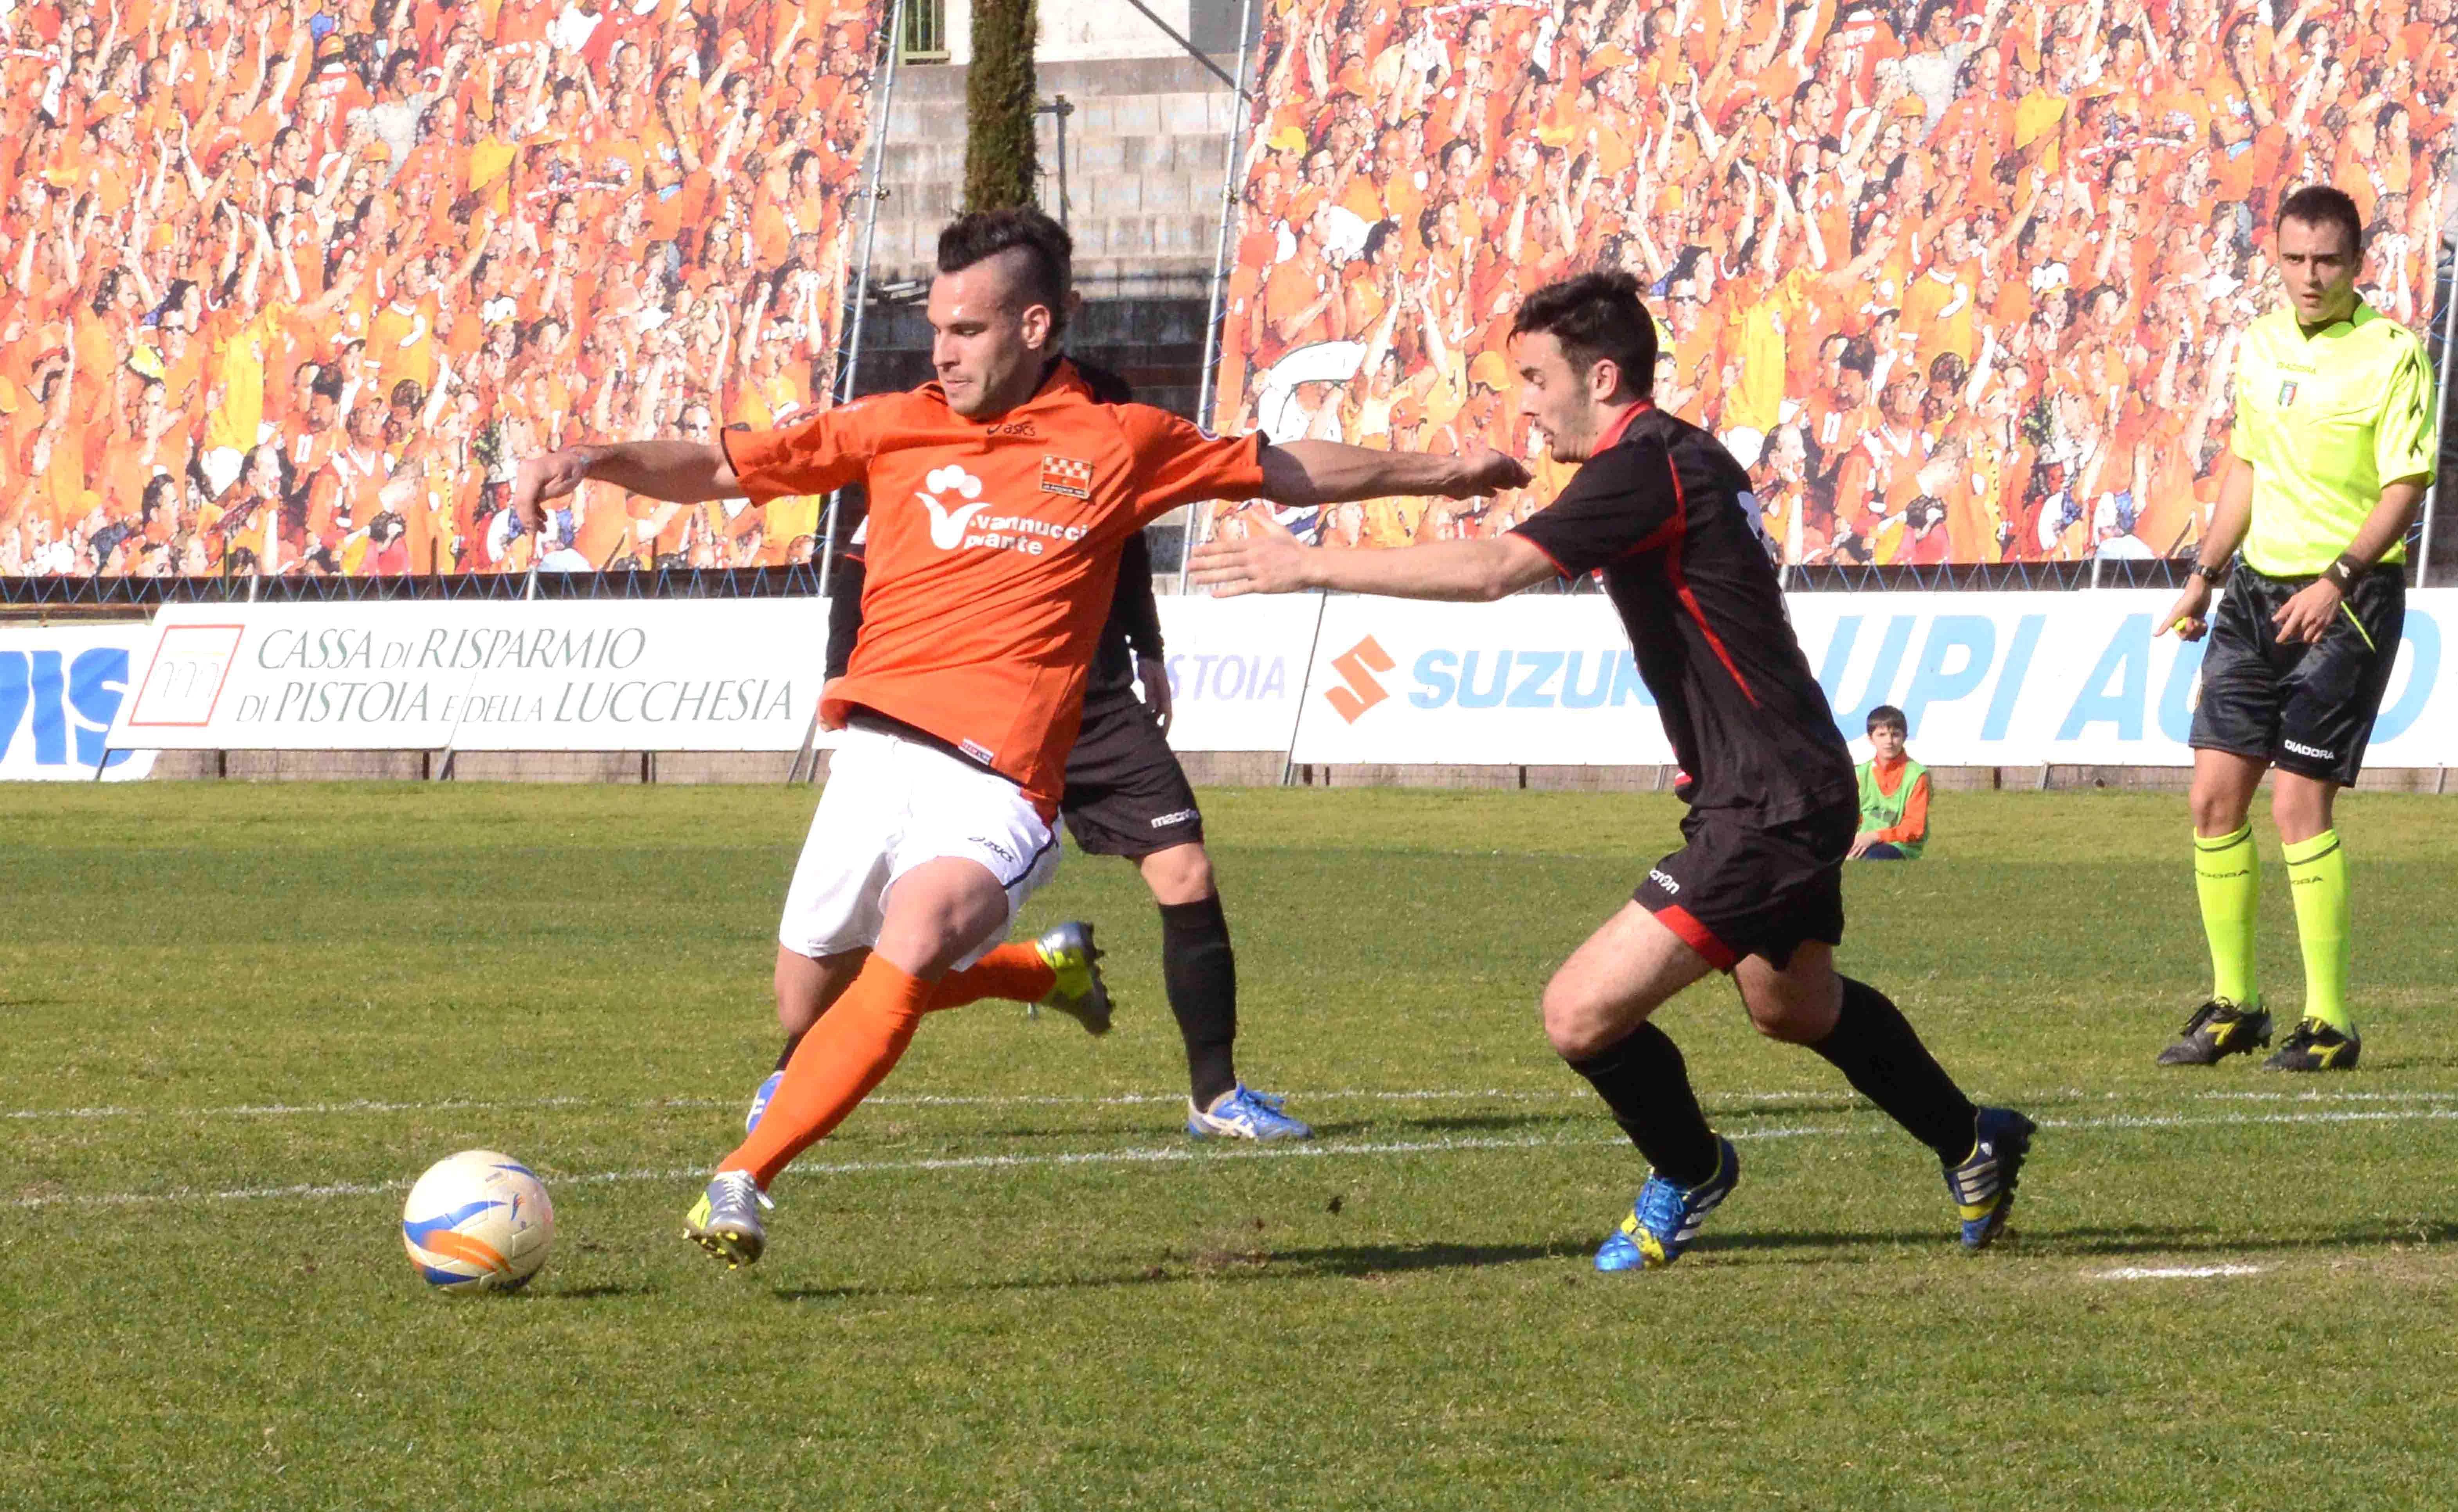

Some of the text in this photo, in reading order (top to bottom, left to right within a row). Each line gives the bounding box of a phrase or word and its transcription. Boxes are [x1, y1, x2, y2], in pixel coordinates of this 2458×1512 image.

[976, 514, 1088, 541] vannucci
[258, 628, 646, 670] CASSA DI RISPARMIO
[1409, 649, 1658, 709] SUZUK
[1818, 614, 2047, 742] UPI
[236, 679, 792, 723] DI PISTOIA E DELLA LUCCHESIA
[2284, 739, 2335, 760] DIADORA
